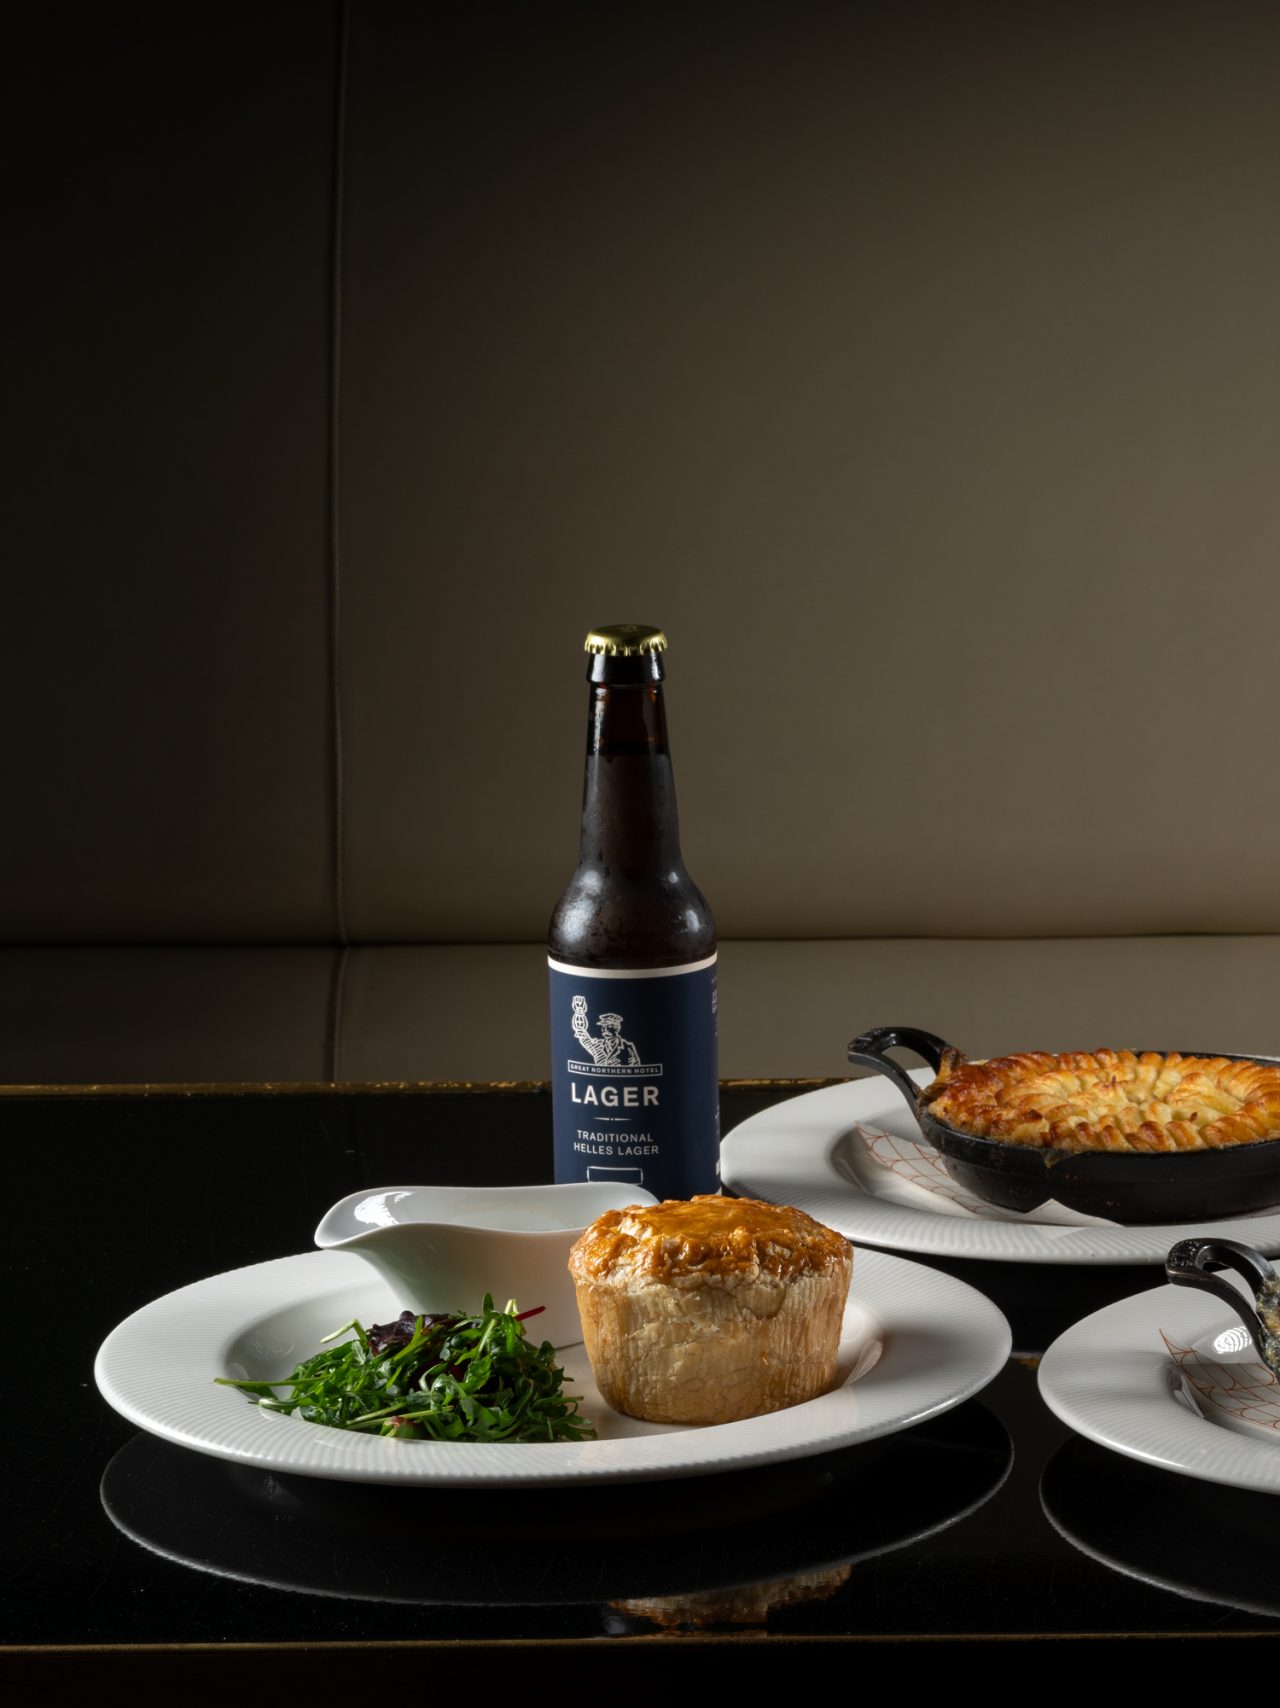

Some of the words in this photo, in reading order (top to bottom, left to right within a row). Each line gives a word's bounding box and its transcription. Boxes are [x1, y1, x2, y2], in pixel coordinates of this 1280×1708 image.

[570, 1063, 589, 1072] GREAT
[571, 1082, 660, 1107] LAGER
[577, 1129, 654, 1143] TRADITIONAL
[573, 1142, 613, 1155] HELLES
[618, 1144, 660, 1156] LAGER
